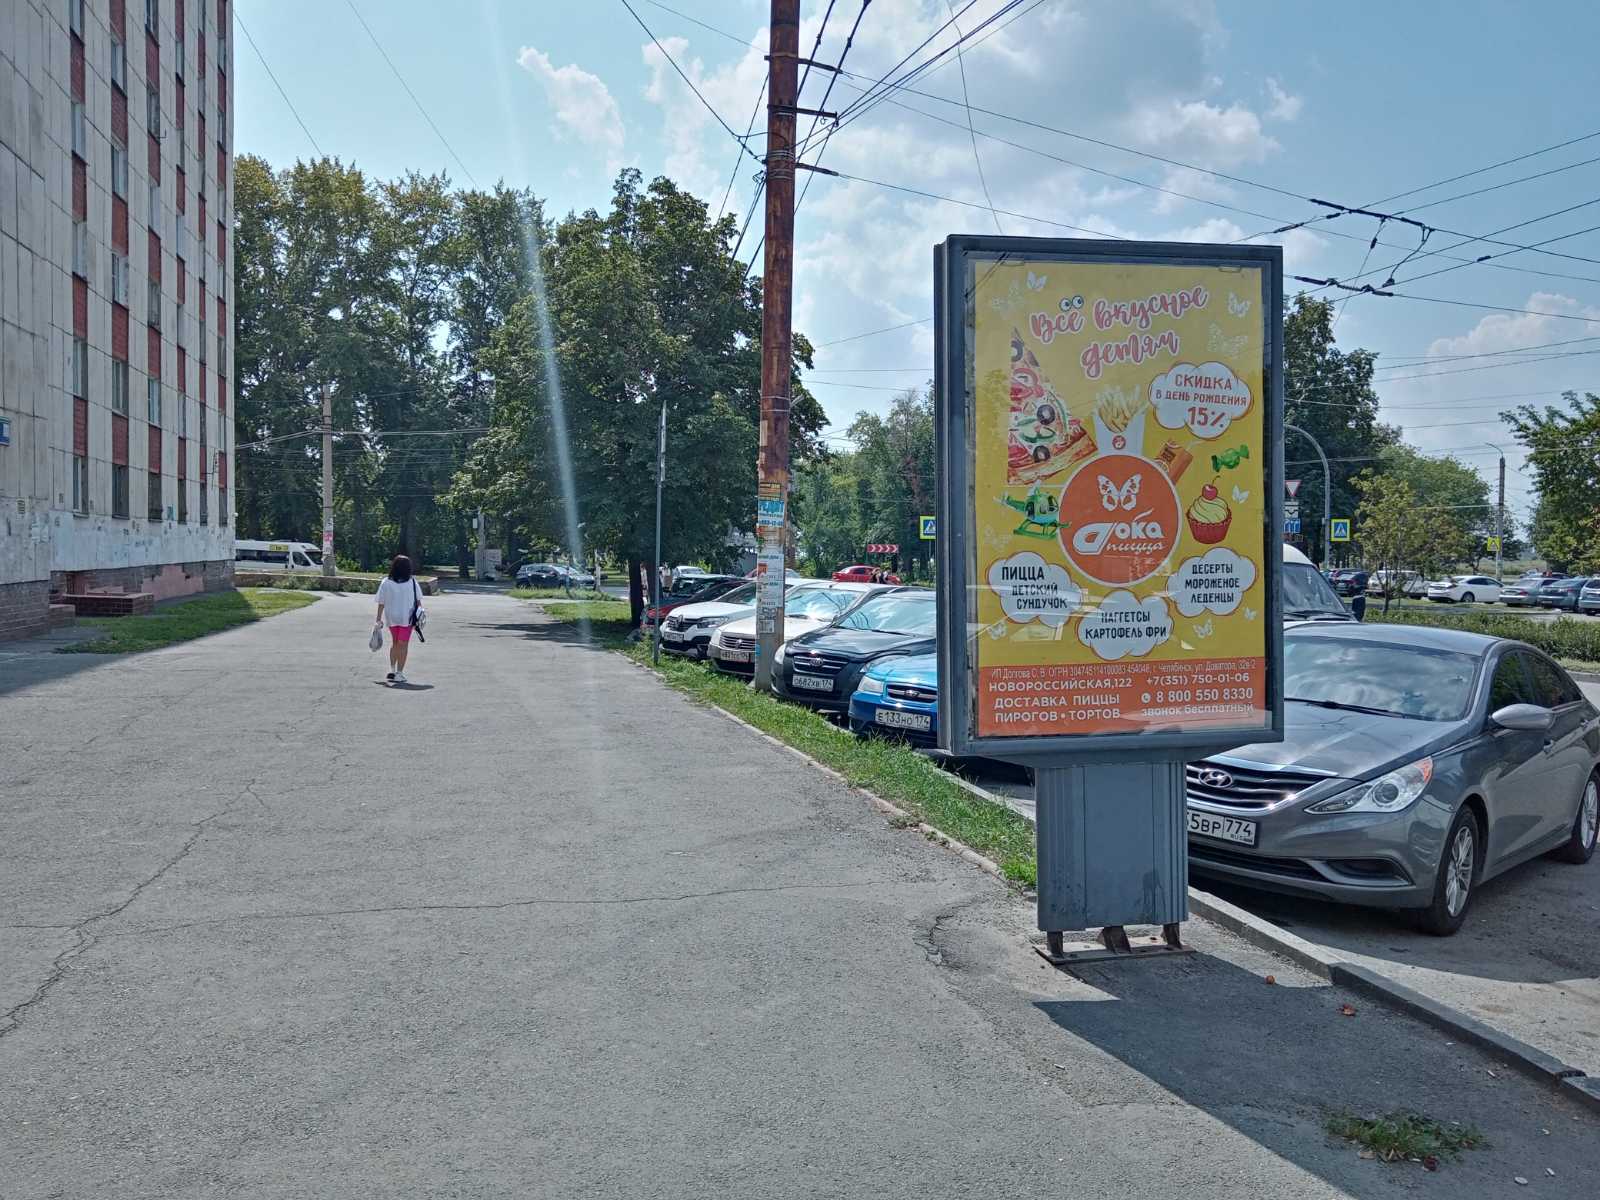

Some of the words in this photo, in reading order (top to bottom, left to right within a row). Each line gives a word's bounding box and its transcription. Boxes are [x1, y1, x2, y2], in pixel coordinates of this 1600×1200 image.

[1081, 331, 1179, 379] детям
[1175, 374, 1232, 391] СКИДКА
[1155, 389, 1162, 400] В
[1165, 391, 1191, 402] ДЕНЬ
[1193, 393, 1247, 406] РОЖДЕНИЯ
[1187, 406, 1226, 428] 15%
[1001, 566, 1045, 582] ПИЦЦА
[1192, 563, 1233, 575] ДЕСЕРТЫ
[1011, 583, 1058, 596] ДЕТСКИЙ
[1184, 578, 1240, 590] МОРОЖЕНОЕ
[1016, 598, 1068, 610] СУНДУЧОК
[1190, 592, 1234, 604] ЛЕДЕНЦЫ
[1101, 611, 1151, 623] НАГГЕТСЫ
[1084, 627, 1143, 640] КАРТОФЕЛЬ
[1145, 626, 1167, 638] ФРИ
[1146, 675, 1188, 686] +7(351)
[1192, 672, 1250, 684] 750-01-06
[994, 696, 1067, 710] ДОСТАВКА
[1073, 694, 1120, 707] ПИЦЦЫ
[1156, 691, 1164, 703] 8
[1168, 690, 1191, 702] 800
[1196, 689, 1219, 701] 550
[1223, 687, 1253, 700] 8330
[995, 711, 1058, 724] ПИРОГОВ
[1069, 708, 1120, 721] ТОРТОВ
[1141, 706, 1182, 717] звонок
[1184, 702, 1255, 714] бесплатный
[915, 715, 929, 728] 174
[1187, 812, 1221, 835] 5ВР
[1225, 818, 1251, 837] 774
